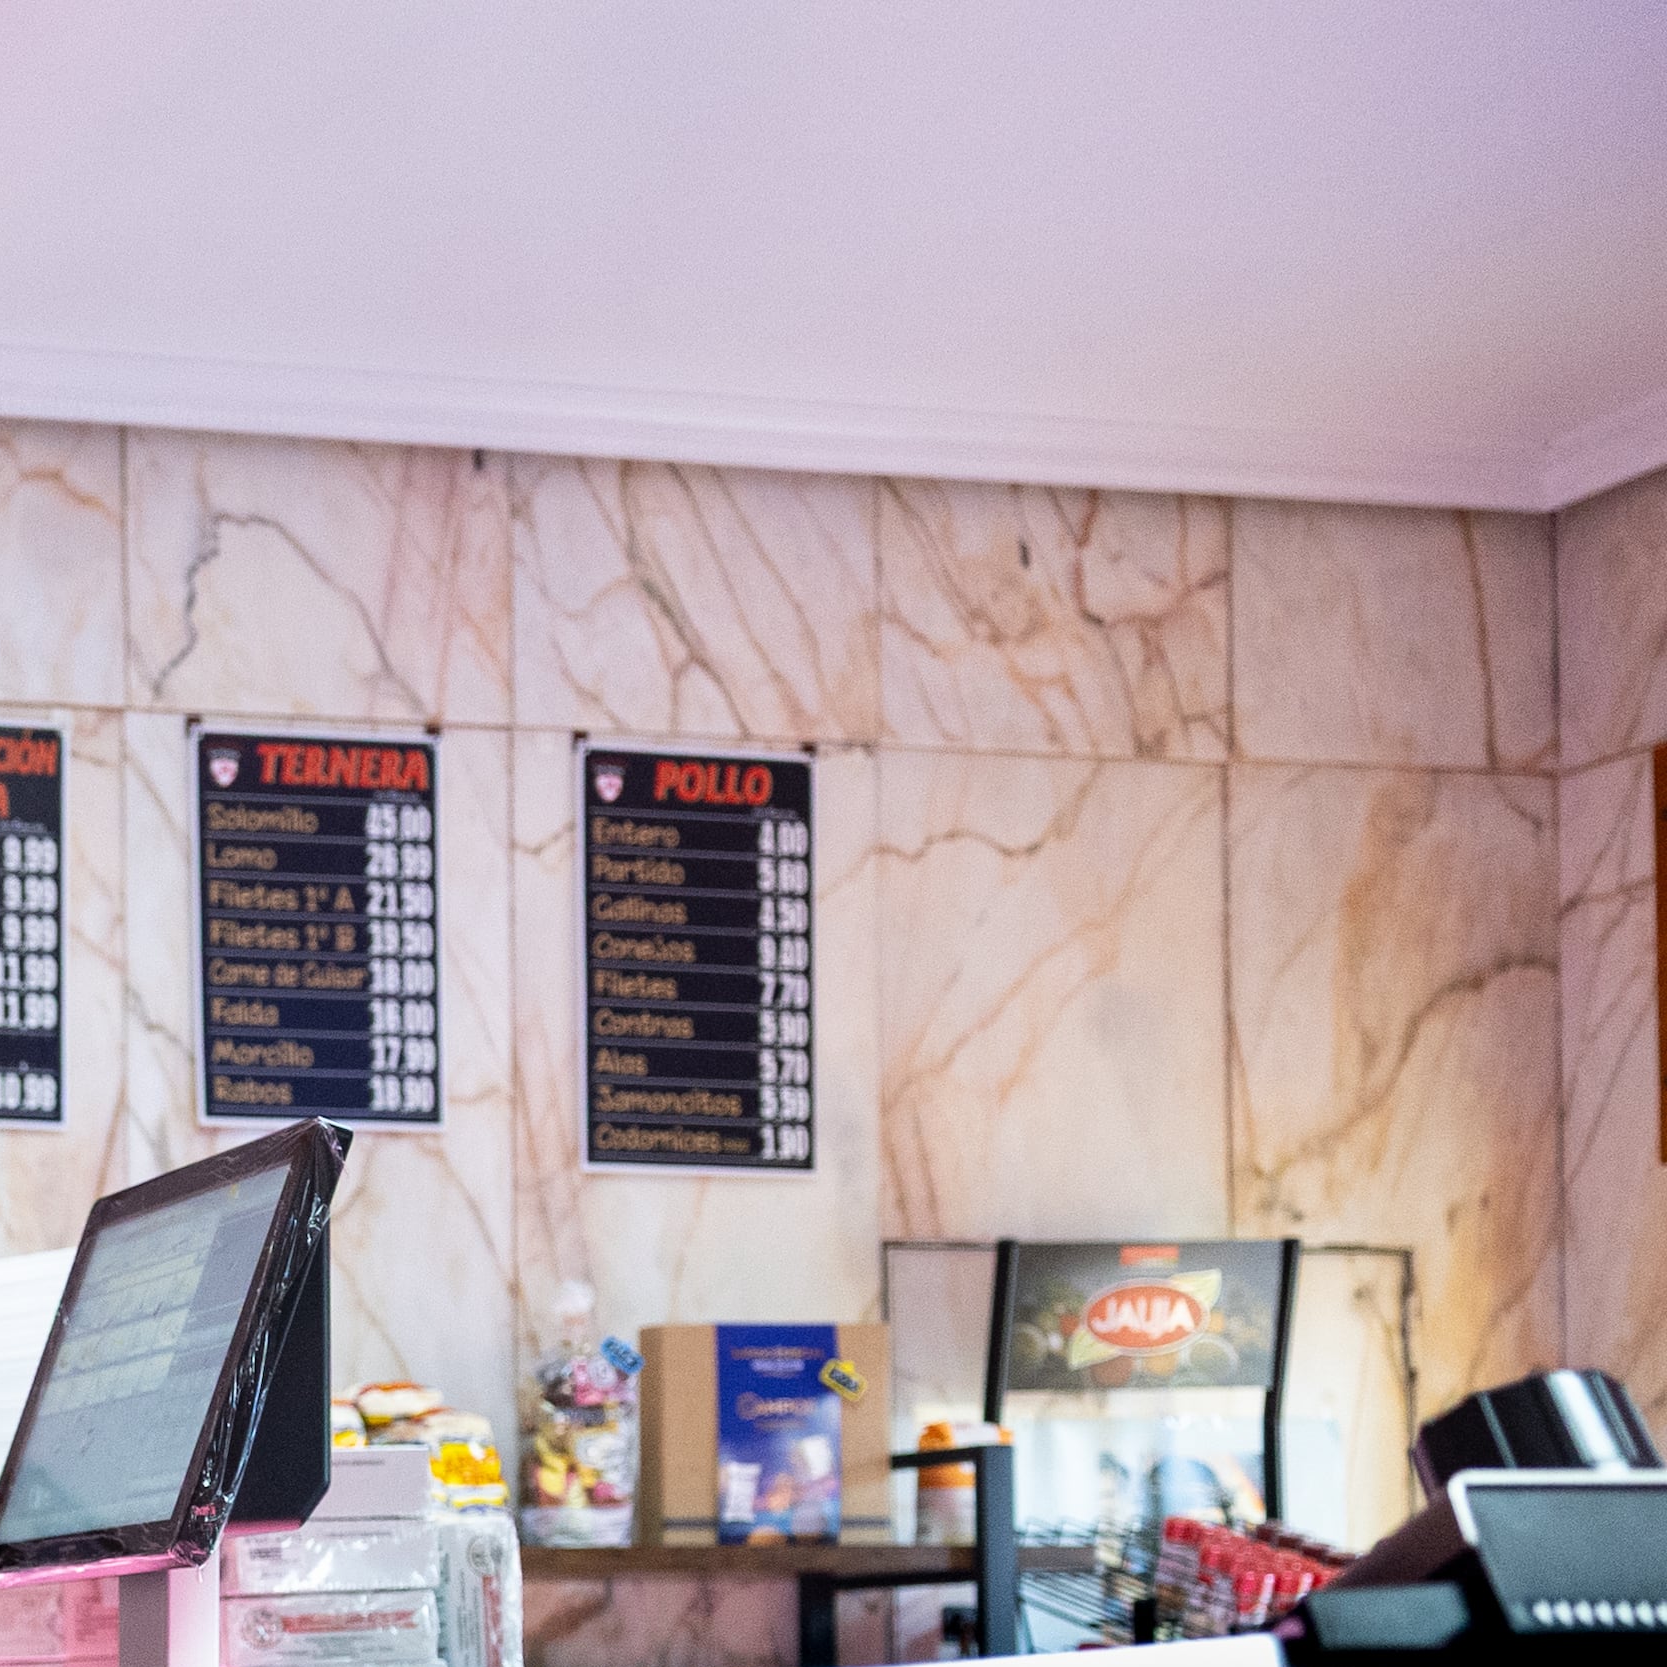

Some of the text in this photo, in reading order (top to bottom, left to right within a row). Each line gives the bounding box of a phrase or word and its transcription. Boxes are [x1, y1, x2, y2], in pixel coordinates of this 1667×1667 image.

[256, 743, 430, 791] TERNERA
[653, 760, 773, 806] POLLO
[206, 802, 319, 834] Solomillo
[591, 817, 681, 848] Entero
[206, 841, 277, 870] Lomo
[208, 880, 300, 910] Filetes
[333, 886, 355, 911] A
[209, 920, 300, 950] Filetes
[334, 924, 356, 951] B
[208, 959, 270, 986] Carne
[274, 961, 300, 987] de
[592, 969, 679, 1000] Filetes
[211, 998, 280, 1026] Falda
[212, 1038, 314, 1067] Morcillo
[593, 1047, 649, 1076] Alas
[213, 1076, 294, 1105] Rabos
